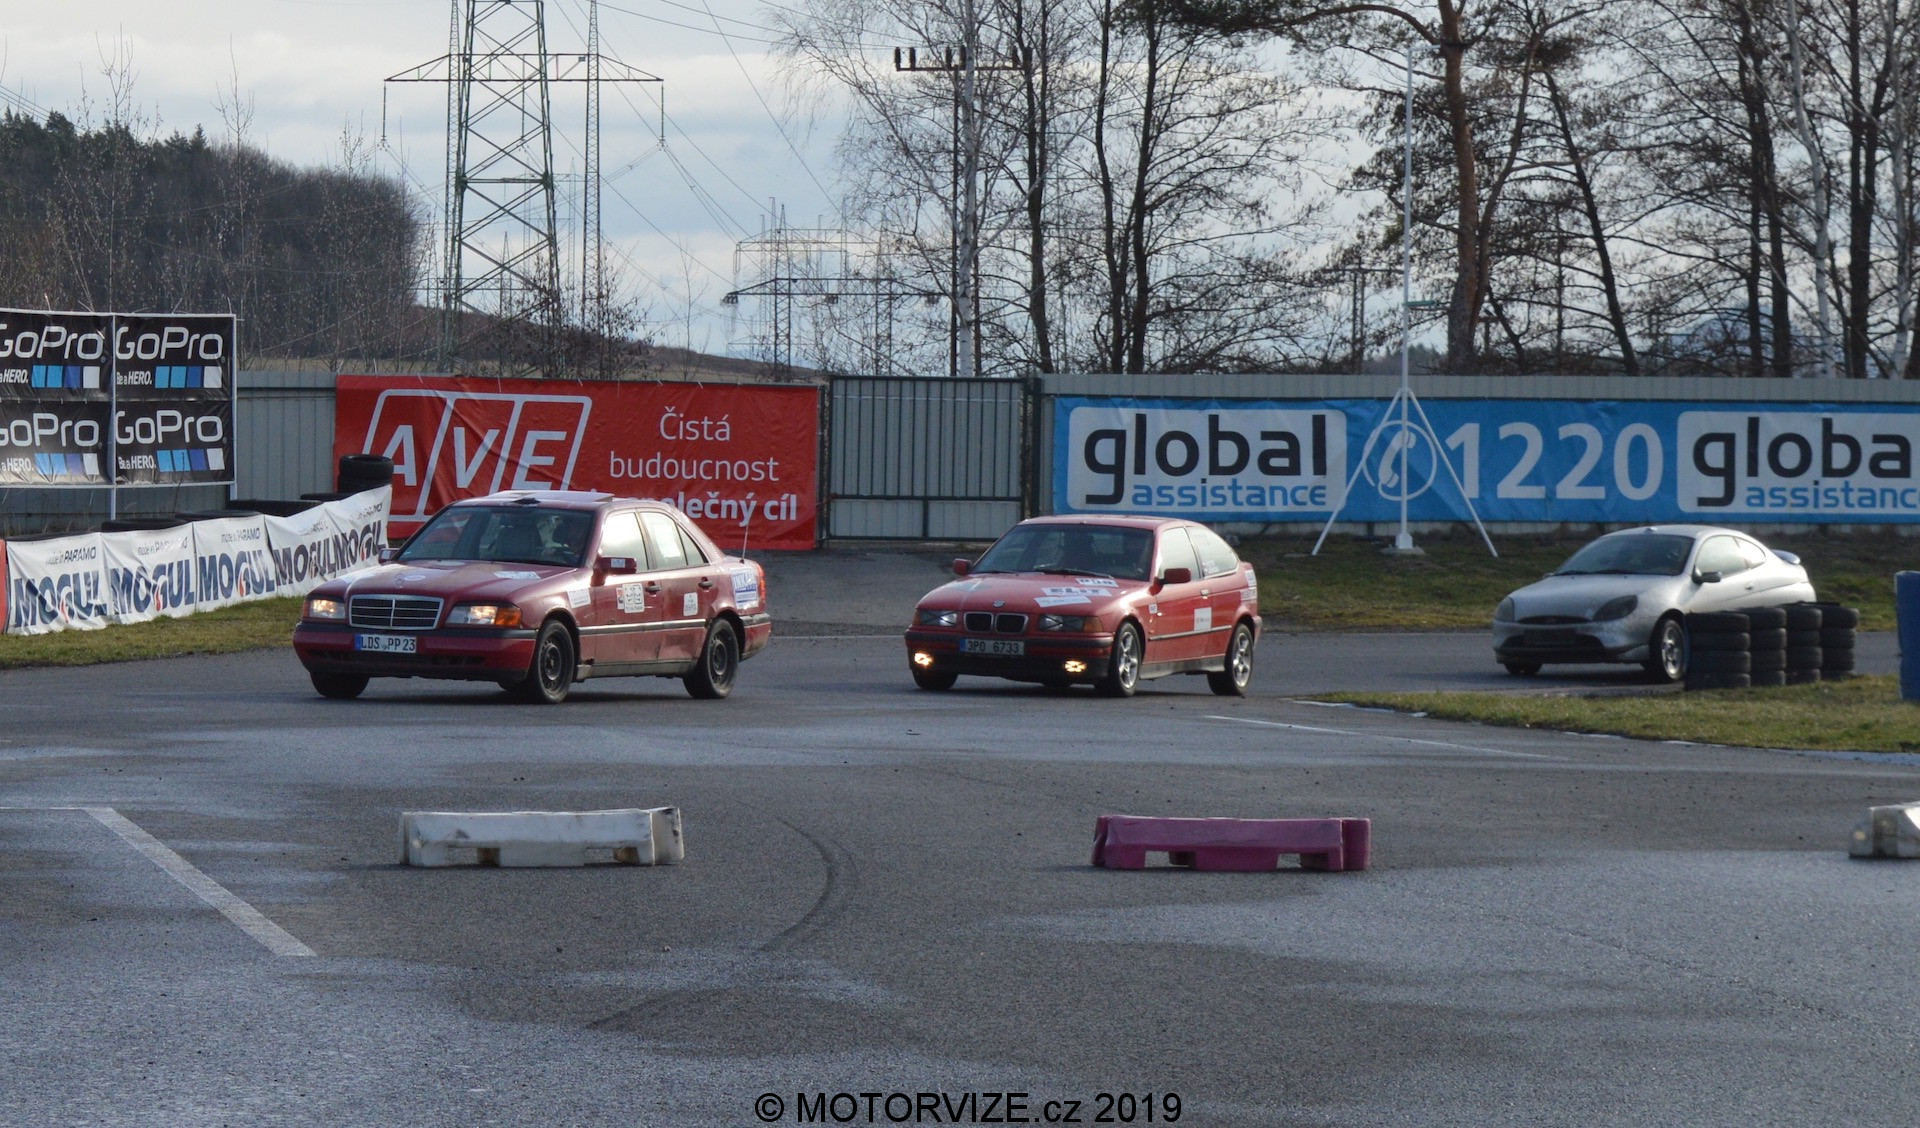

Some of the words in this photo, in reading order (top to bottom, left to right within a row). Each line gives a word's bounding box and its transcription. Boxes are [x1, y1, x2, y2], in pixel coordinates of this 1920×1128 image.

[115, 326, 223, 360] GoPro
[128, 371, 152, 384] HERO.
[115, 410, 223, 444] GoPro
[660, 406, 731, 441] Čistá
[131, 455, 157, 469] HERO.
[383, 424, 567, 491] AVE
[609, 451, 780, 482] budoucnost
[1084, 413, 1327, 505] global
[1444, 421, 1664, 500] 1220
[1693, 416, 1912, 507] globa
[763, 493, 797, 521] cíl
[1131, 478, 1327, 507] assistance
[1745, 480, 1920, 508] assistanc
[64, 546, 97, 561] PARAMO
[273, 537, 336, 588] MOGUL
[110, 559, 194, 615] MOGUL
[199, 549, 275, 601] MOGUL
[14, 570, 107, 628] MOGUL
[361, 636, 380, 649] LDS
[388, 637, 401, 650] PP
[402, 638, 416, 651] 23
[993, 641, 1019, 653] 6733
